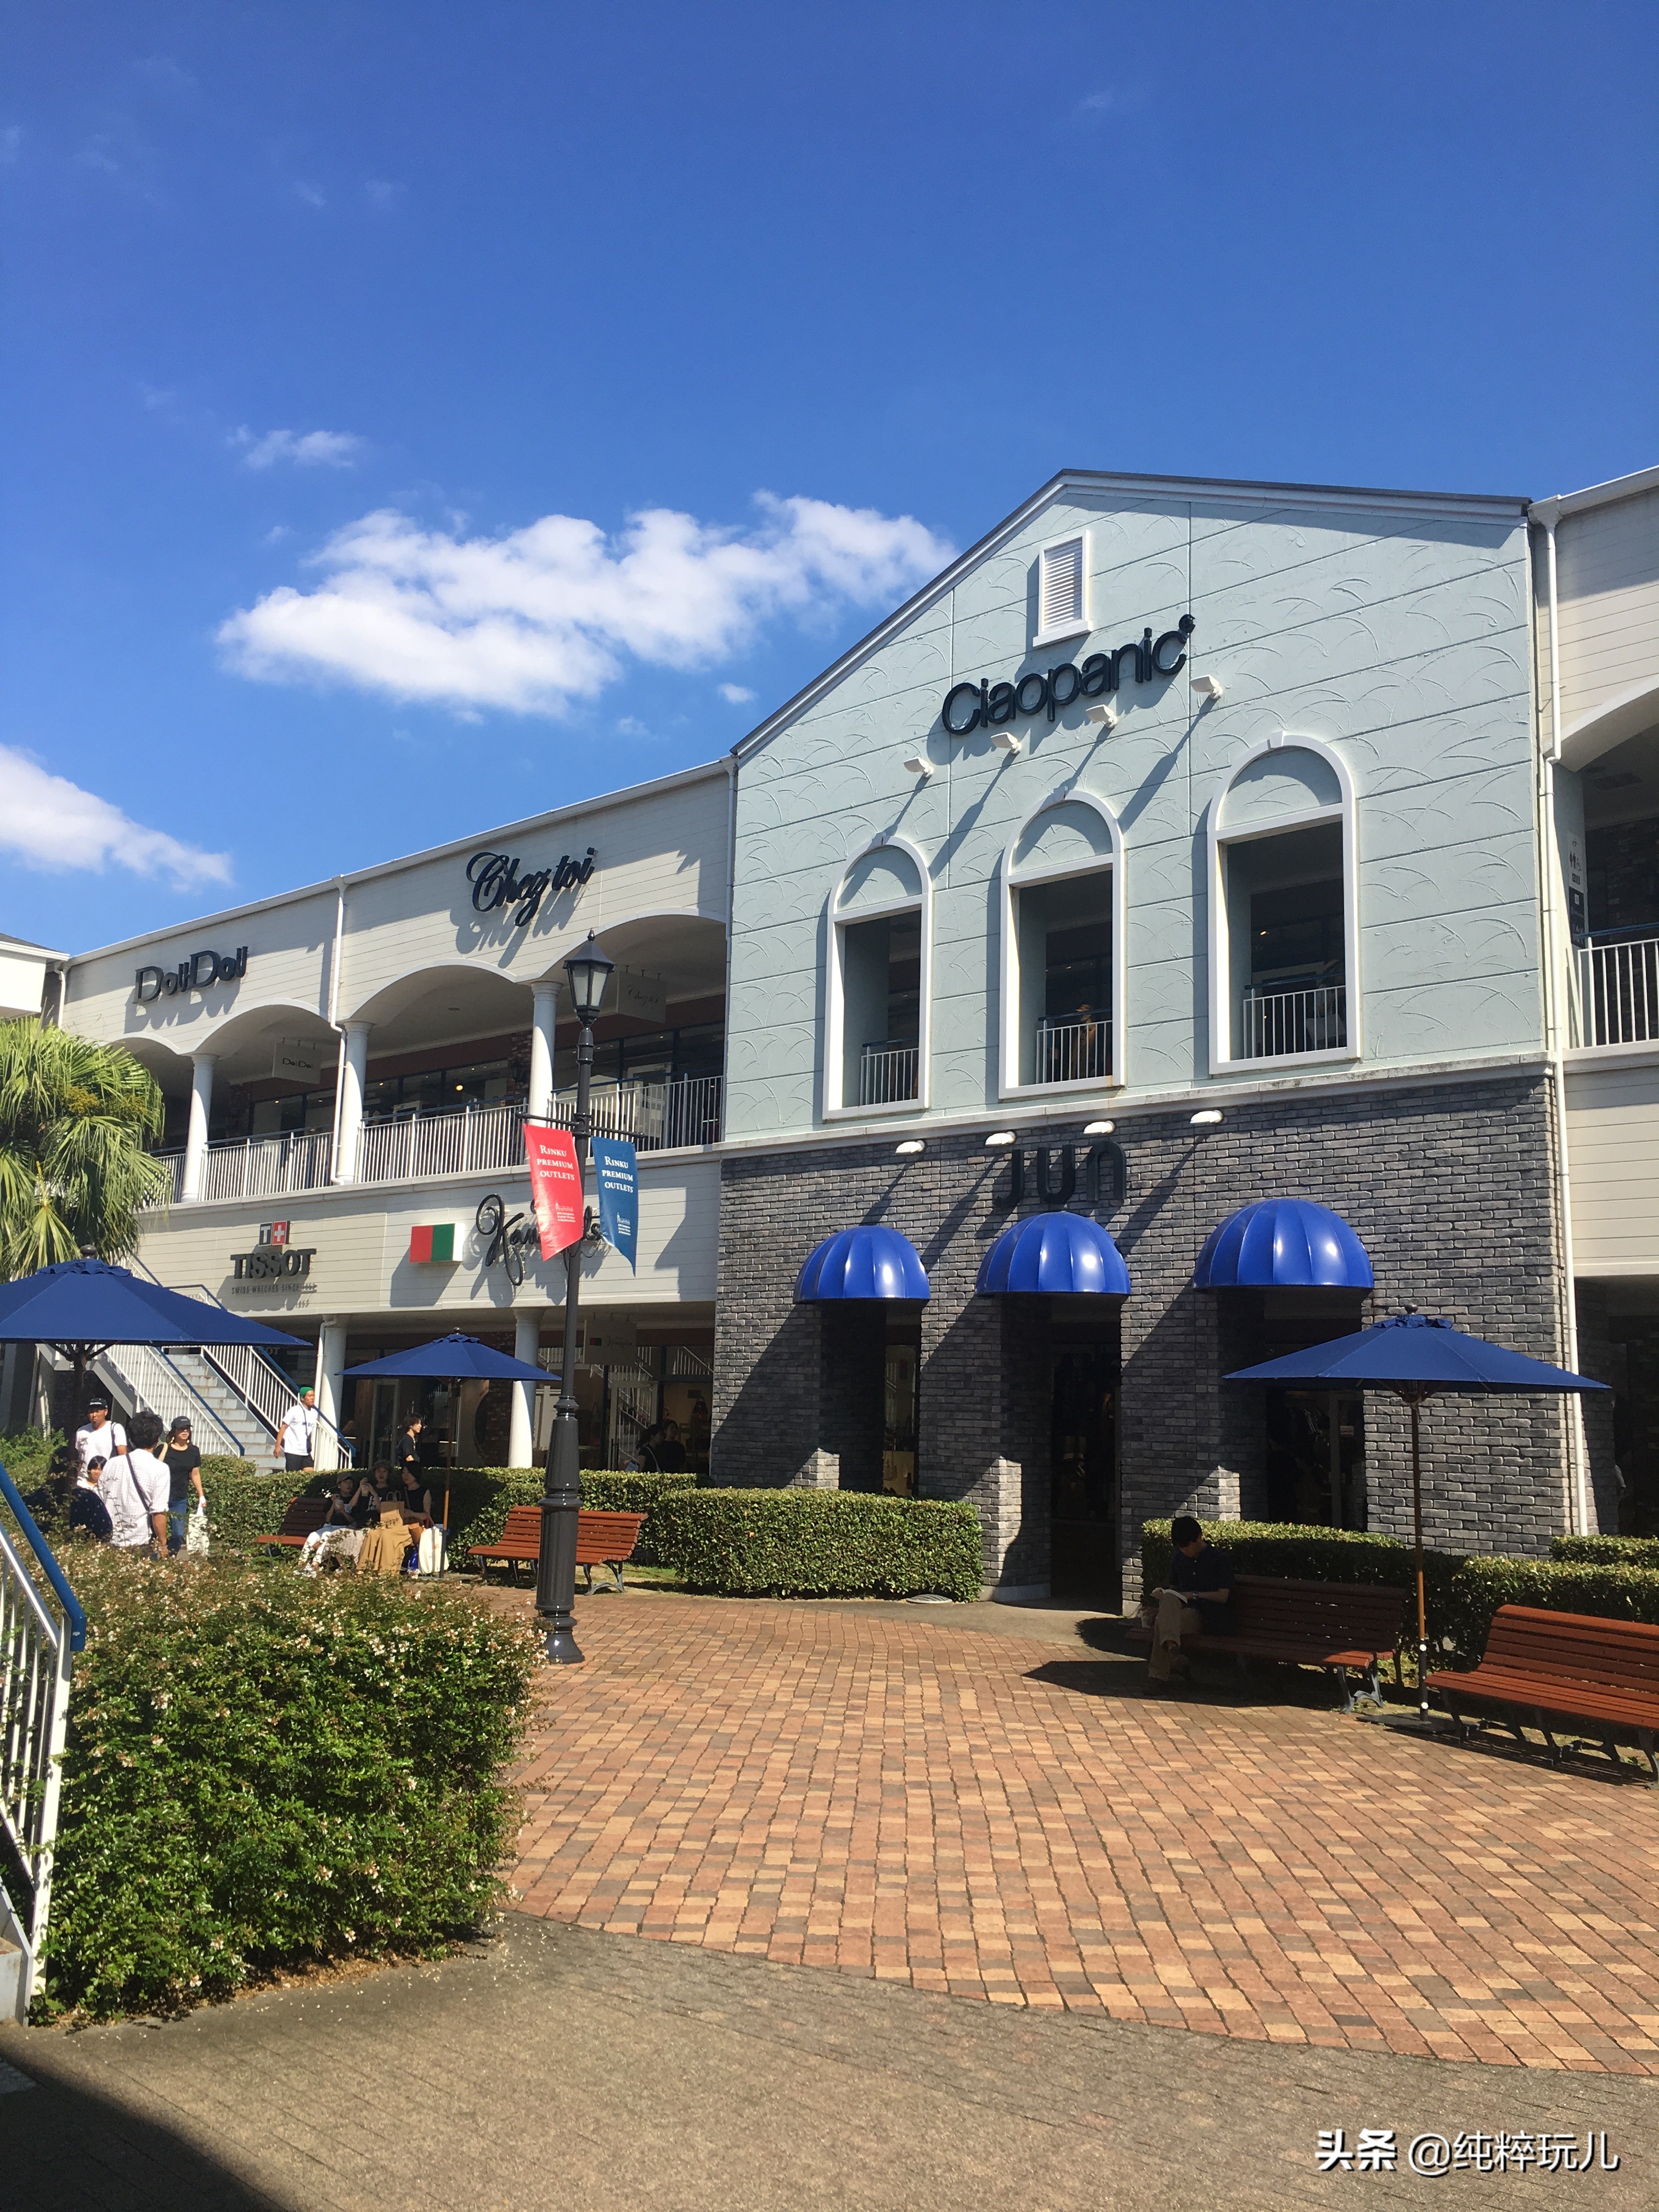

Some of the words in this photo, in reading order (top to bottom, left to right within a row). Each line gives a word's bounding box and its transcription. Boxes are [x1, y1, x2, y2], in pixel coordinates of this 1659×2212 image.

[942, 627, 1187, 736] Ciaopanic
[466, 851, 552, 927] Chez
[552, 847, 595, 891] toi
[537, 1159, 573, 1169] PREMIUM
[540, 1171, 575, 1181] OUTLETS
[602, 1170, 634, 1182] PREMIUM
[605, 1181, 634, 1193] OUTLETS
[230, 1248, 317, 1279] TISSOT
[232, 1286, 249, 1295] SWISS
